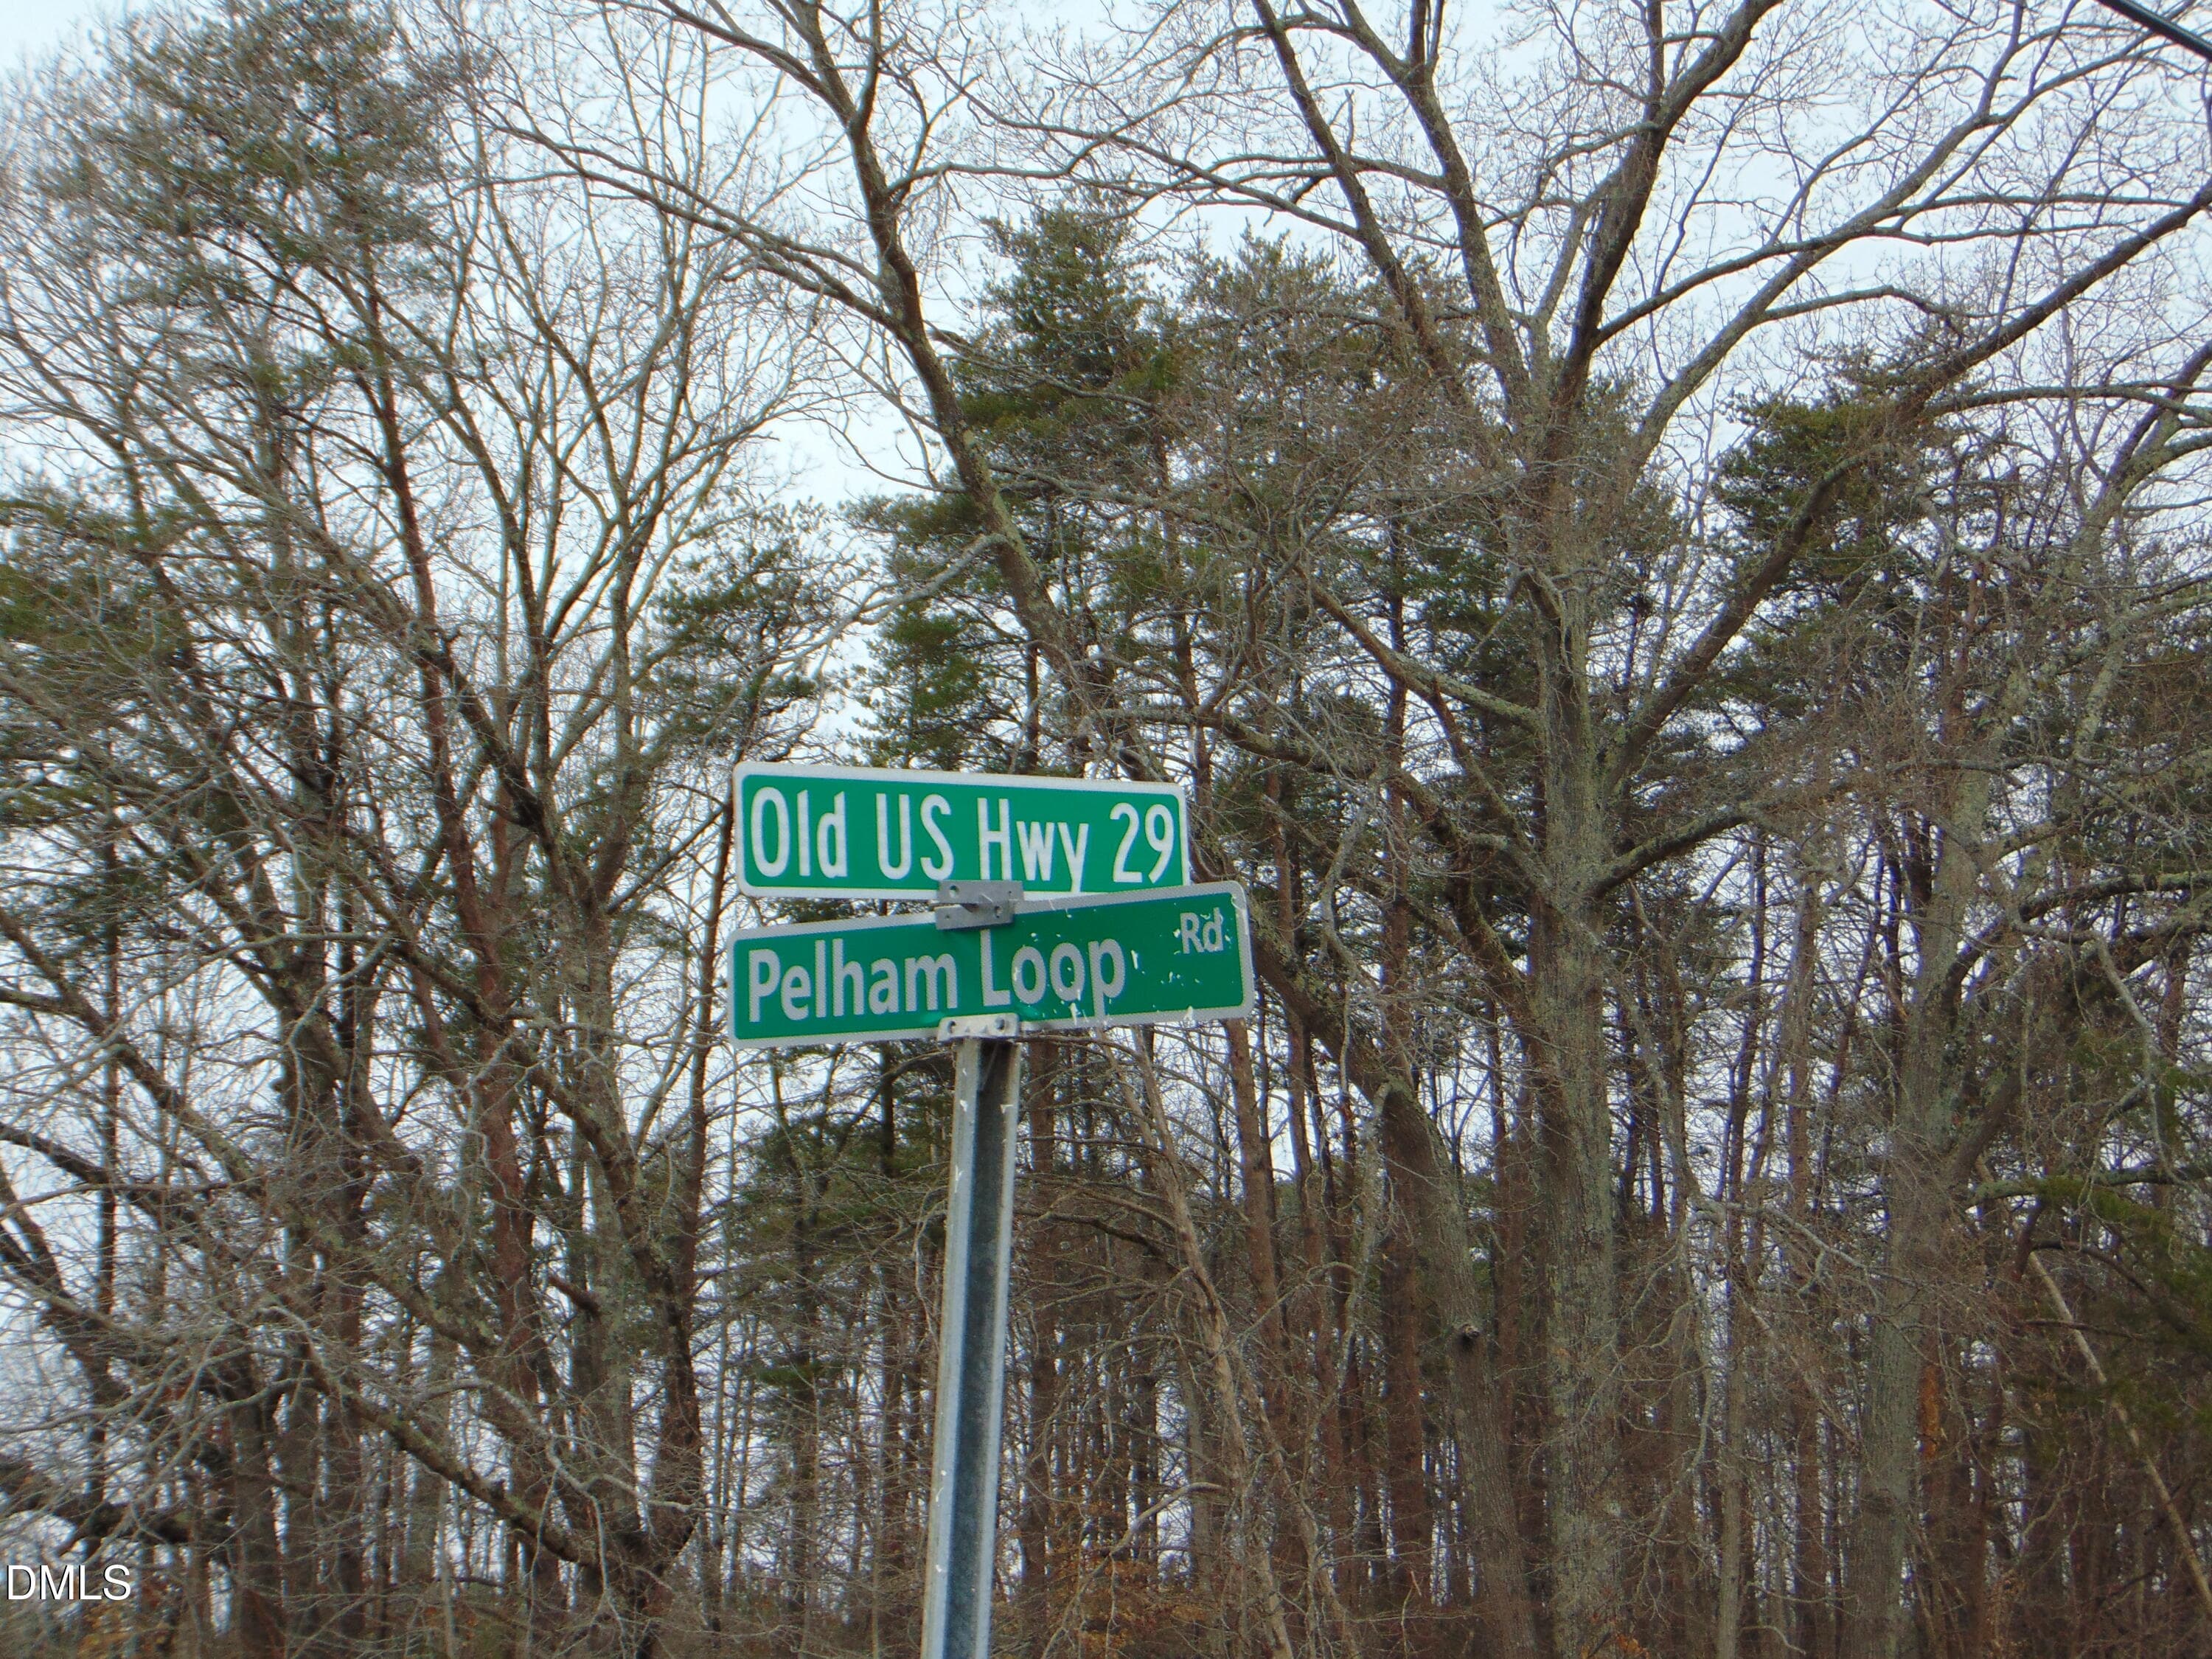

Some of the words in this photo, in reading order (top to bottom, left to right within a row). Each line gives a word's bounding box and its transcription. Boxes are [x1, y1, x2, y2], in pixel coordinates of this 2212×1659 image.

[751, 786, 847, 878] Old
[875, 793, 955, 881] US
[977, 798, 1089, 894] Hwy
[1109, 802, 1175, 883] 29
[748, 938, 958, 1023] Pelham
[979, 929, 1126, 1021] Loop
[1181, 907, 1224, 955] Rd
